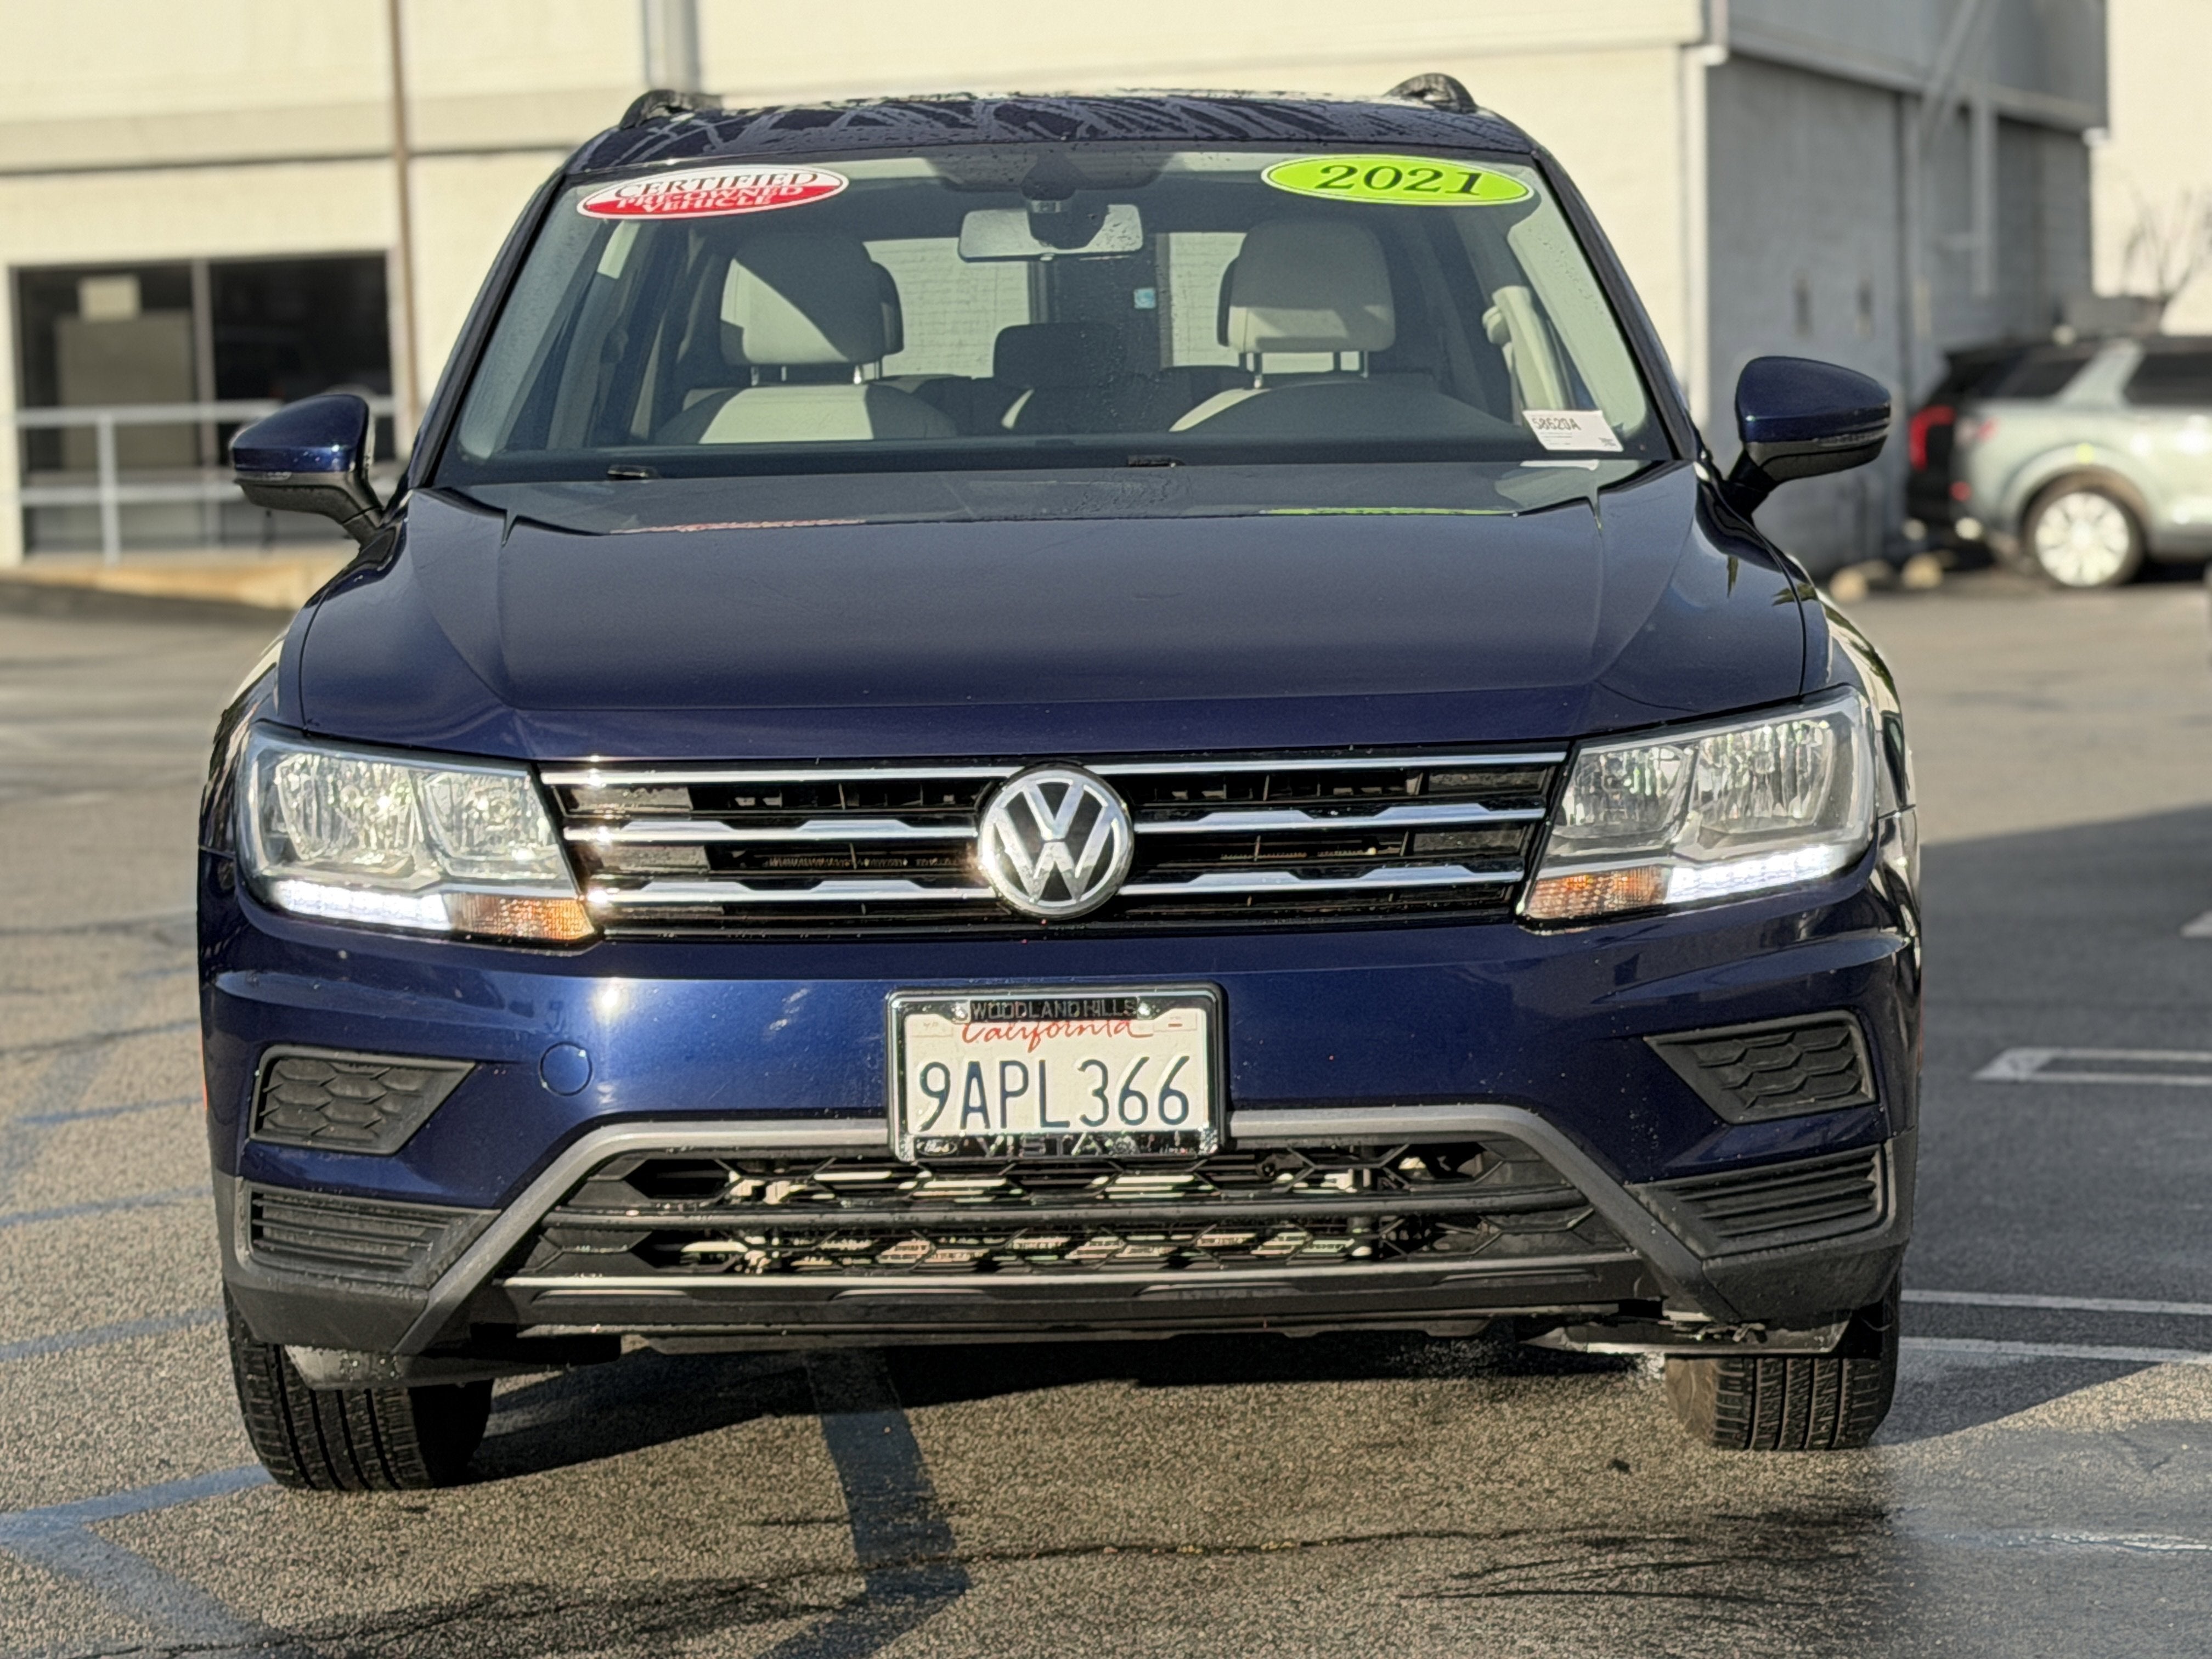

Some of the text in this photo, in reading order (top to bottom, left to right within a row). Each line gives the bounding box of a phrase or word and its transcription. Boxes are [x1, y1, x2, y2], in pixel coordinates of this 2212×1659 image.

[615, 172, 818, 199] CERTIFIED
[1314, 165, 1482, 196] 2021
[617, 185, 804, 208] PRE-OWNED
[642, 195, 771, 213] VEHICLE
[971, 999, 1137, 1020] WOODLAND HILLS
[918, 1056, 1190, 1132] 9APL366
